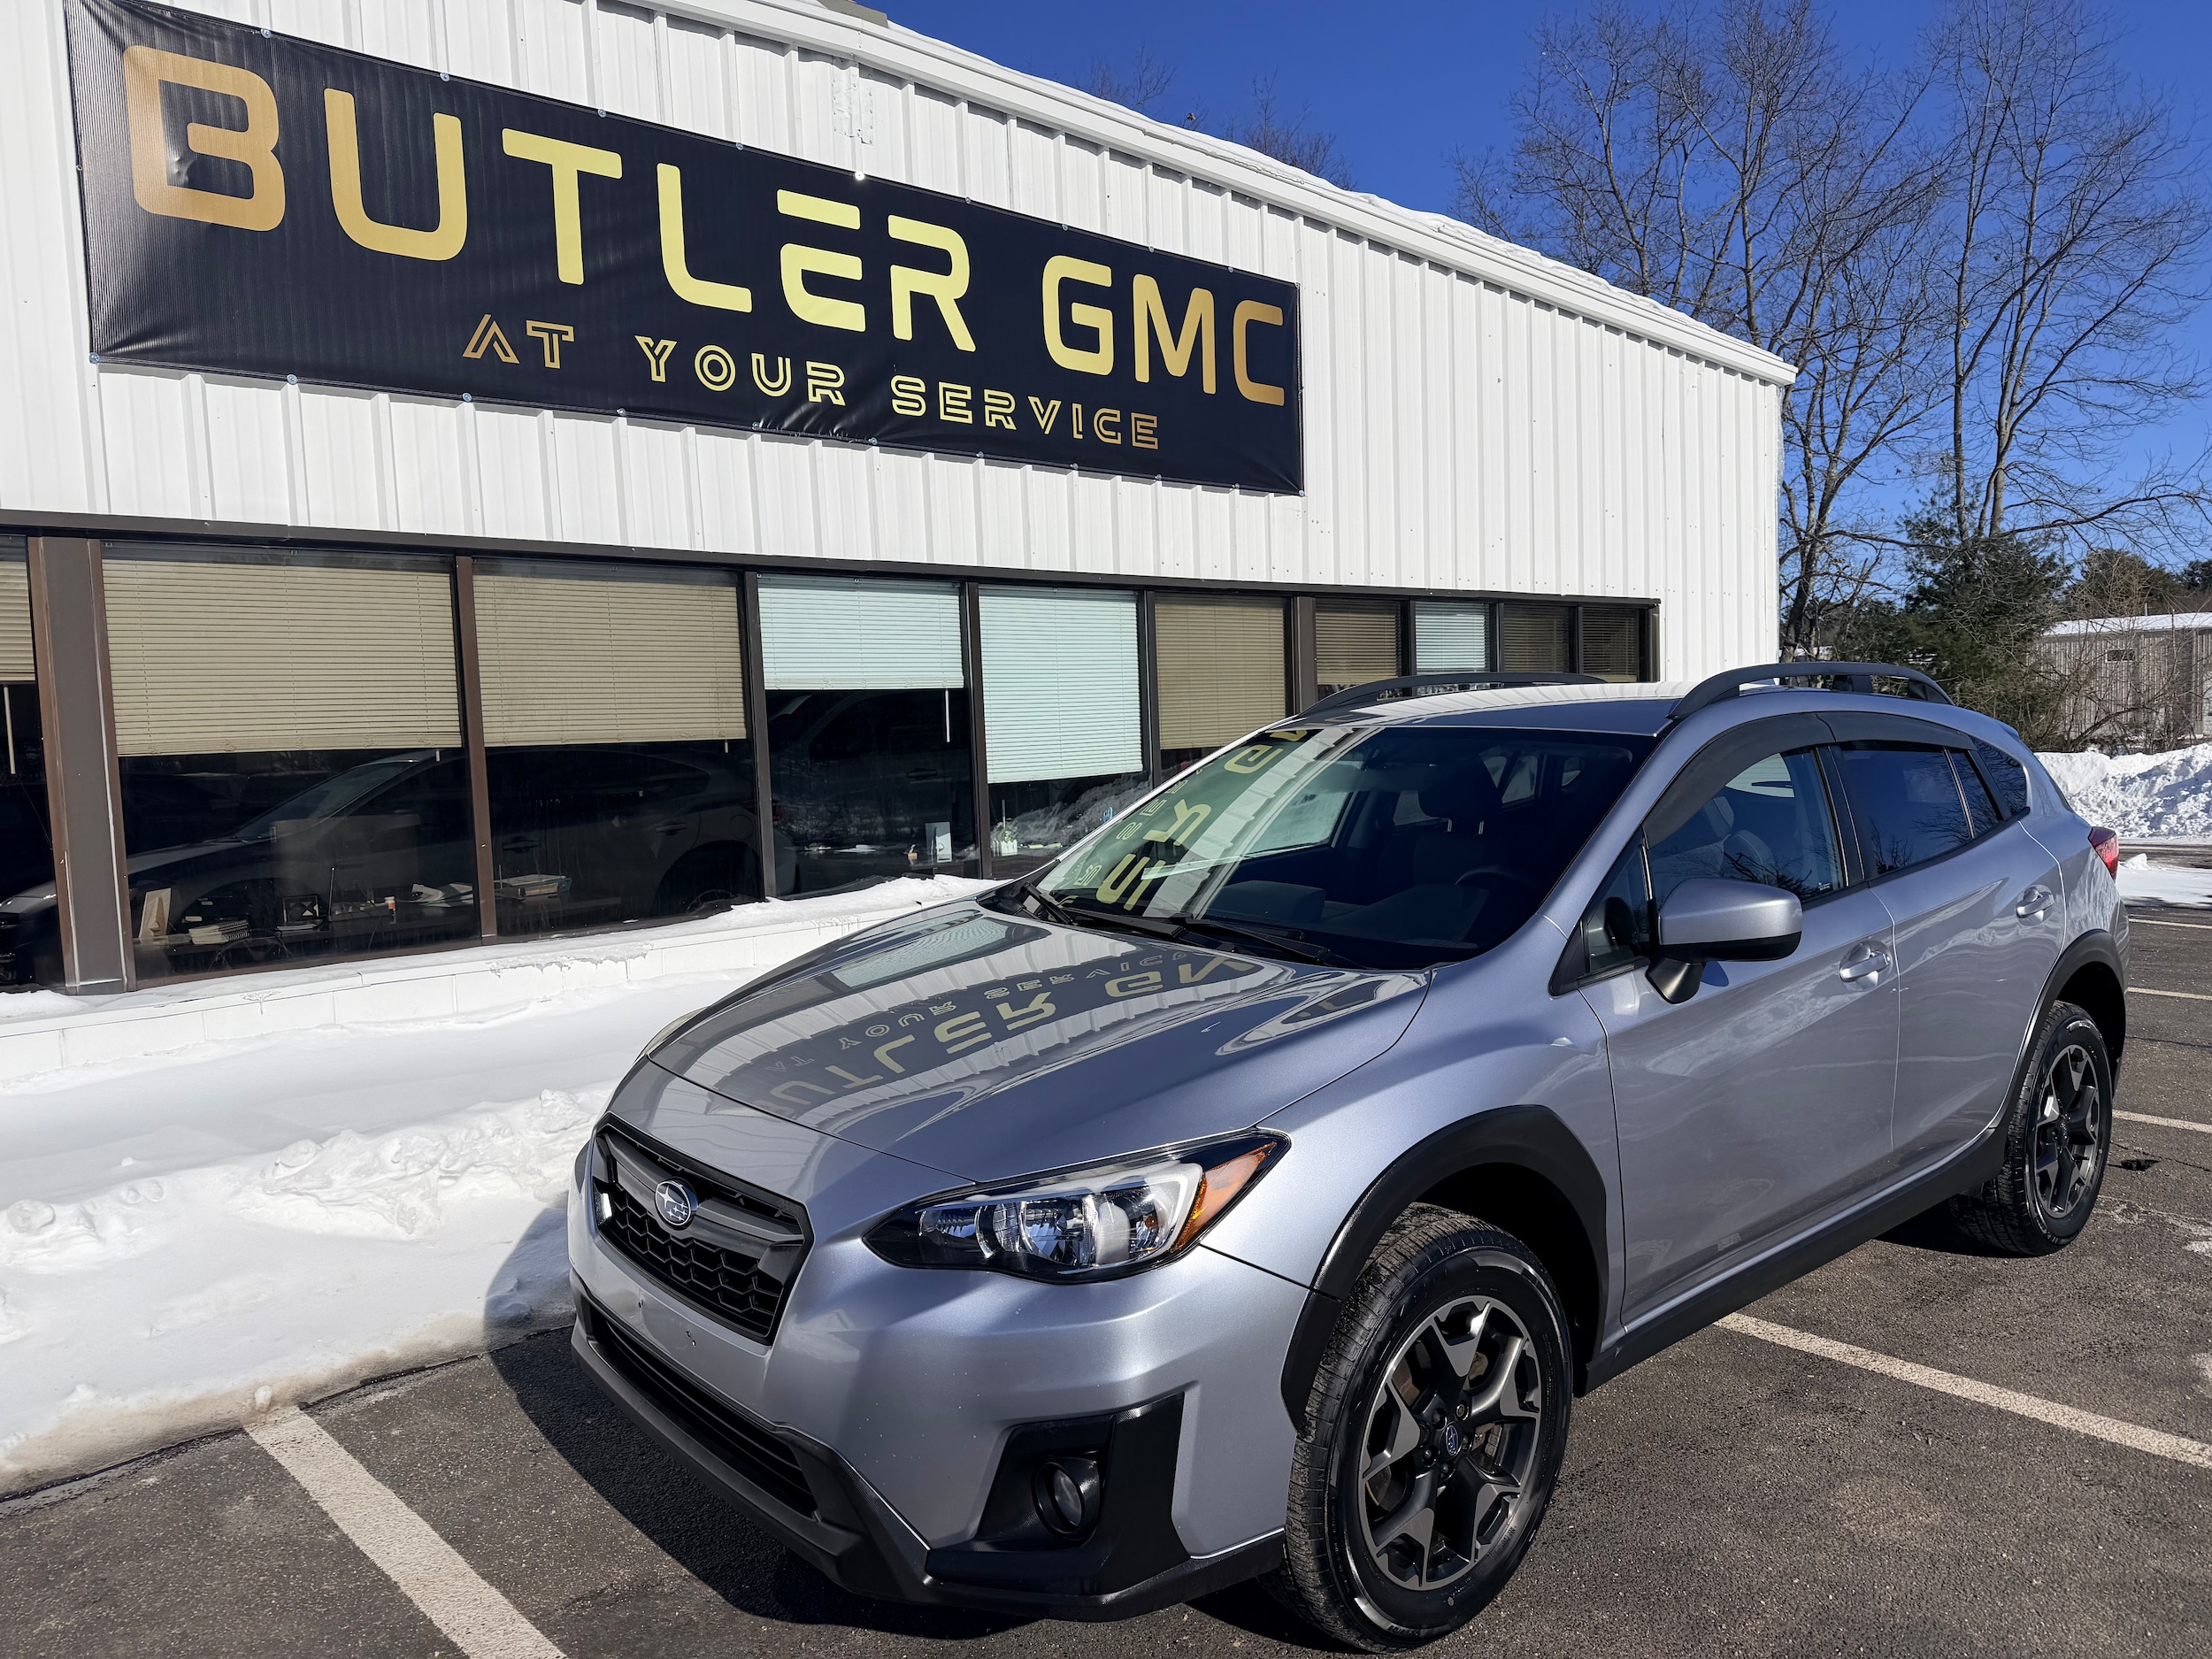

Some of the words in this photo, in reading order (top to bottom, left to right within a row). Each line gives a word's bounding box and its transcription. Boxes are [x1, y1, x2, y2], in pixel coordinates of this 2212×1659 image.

[125, 45, 976, 351] BUTLER
[1042, 256, 1285, 407] GMC
[463, 314, 575, 370] AT
[634, 335, 847, 406] YOUR
[891, 375, 1159, 450] SERVICE
